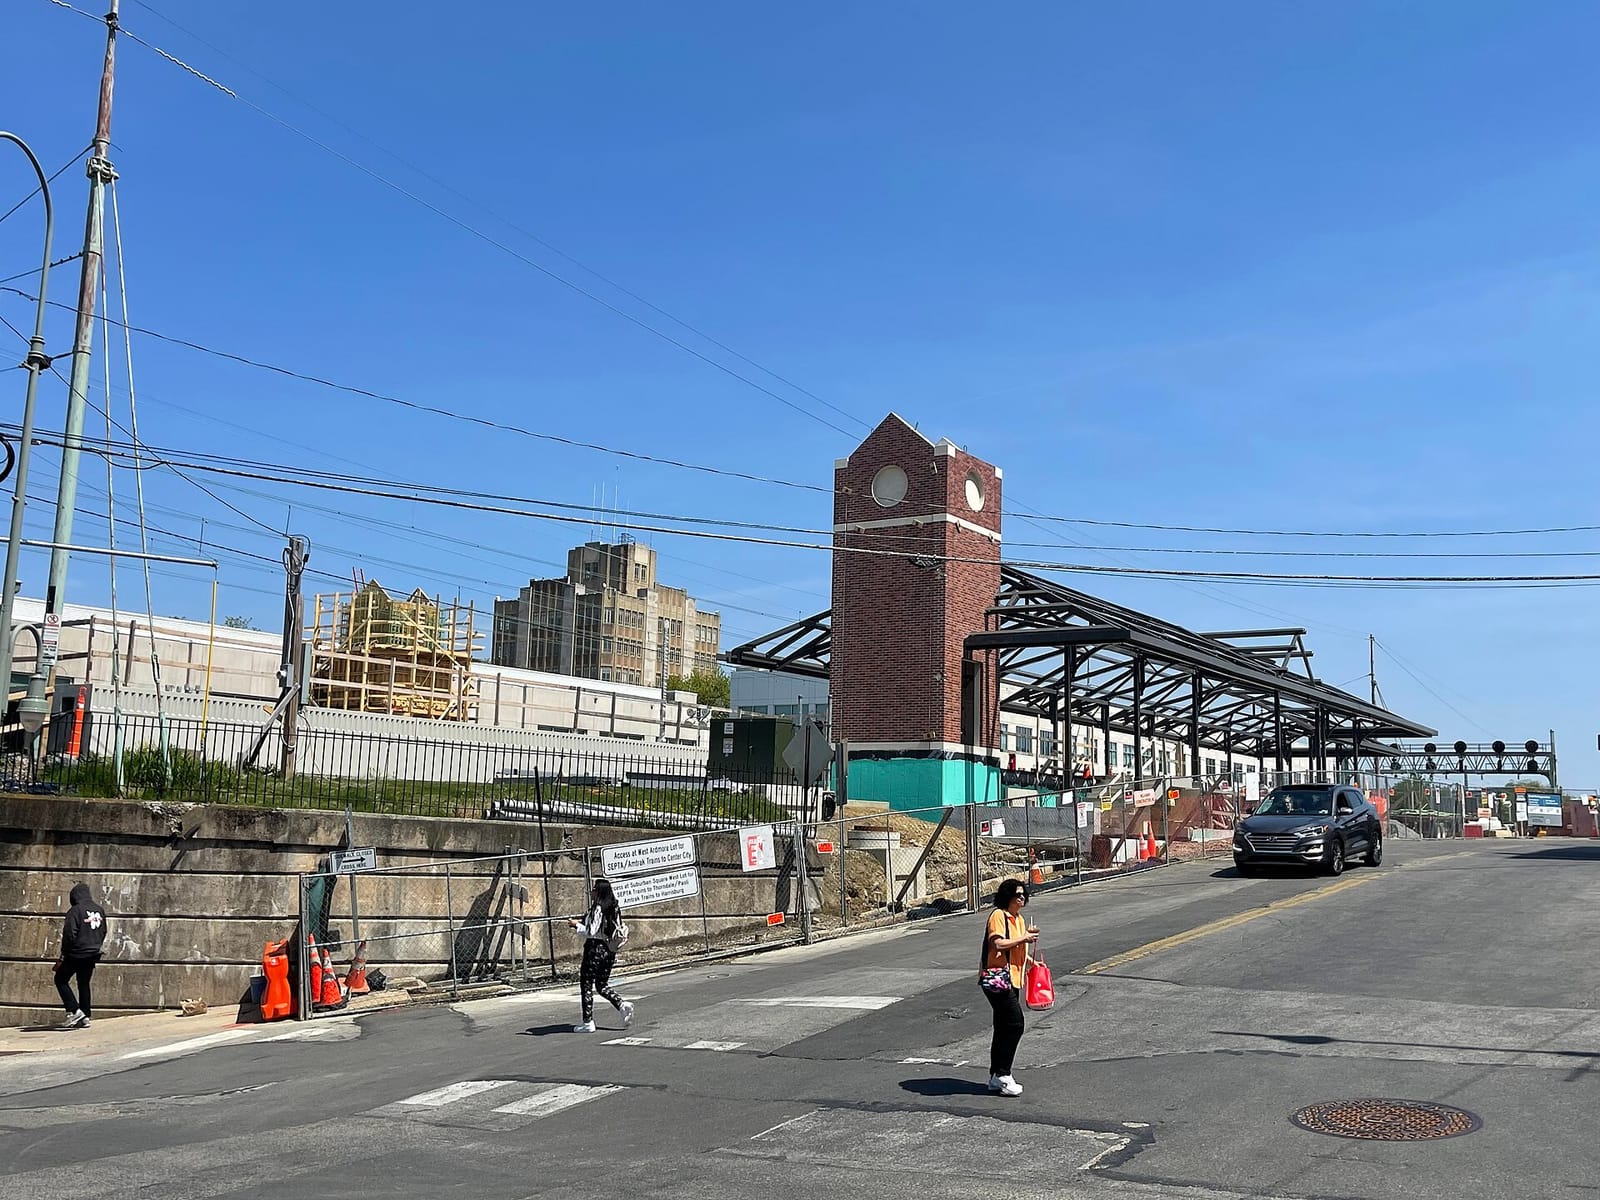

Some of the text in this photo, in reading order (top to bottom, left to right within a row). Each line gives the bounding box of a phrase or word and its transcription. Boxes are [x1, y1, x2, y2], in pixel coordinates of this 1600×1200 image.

[613, 851, 631, 859] Access
[637, 848, 649, 856] West
[649, 845, 669, 854] Ardmore
[669, 843, 677, 851] Lot
[646, 856, 661, 865] Trains
[667, 853, 681, 862] Center
[682, 851, 691, 860] City
[630, 879, 652, 888] Suburban
[616, 890, 632, 898] SEPTA
[623, 896, 640, 904] Amtrak
